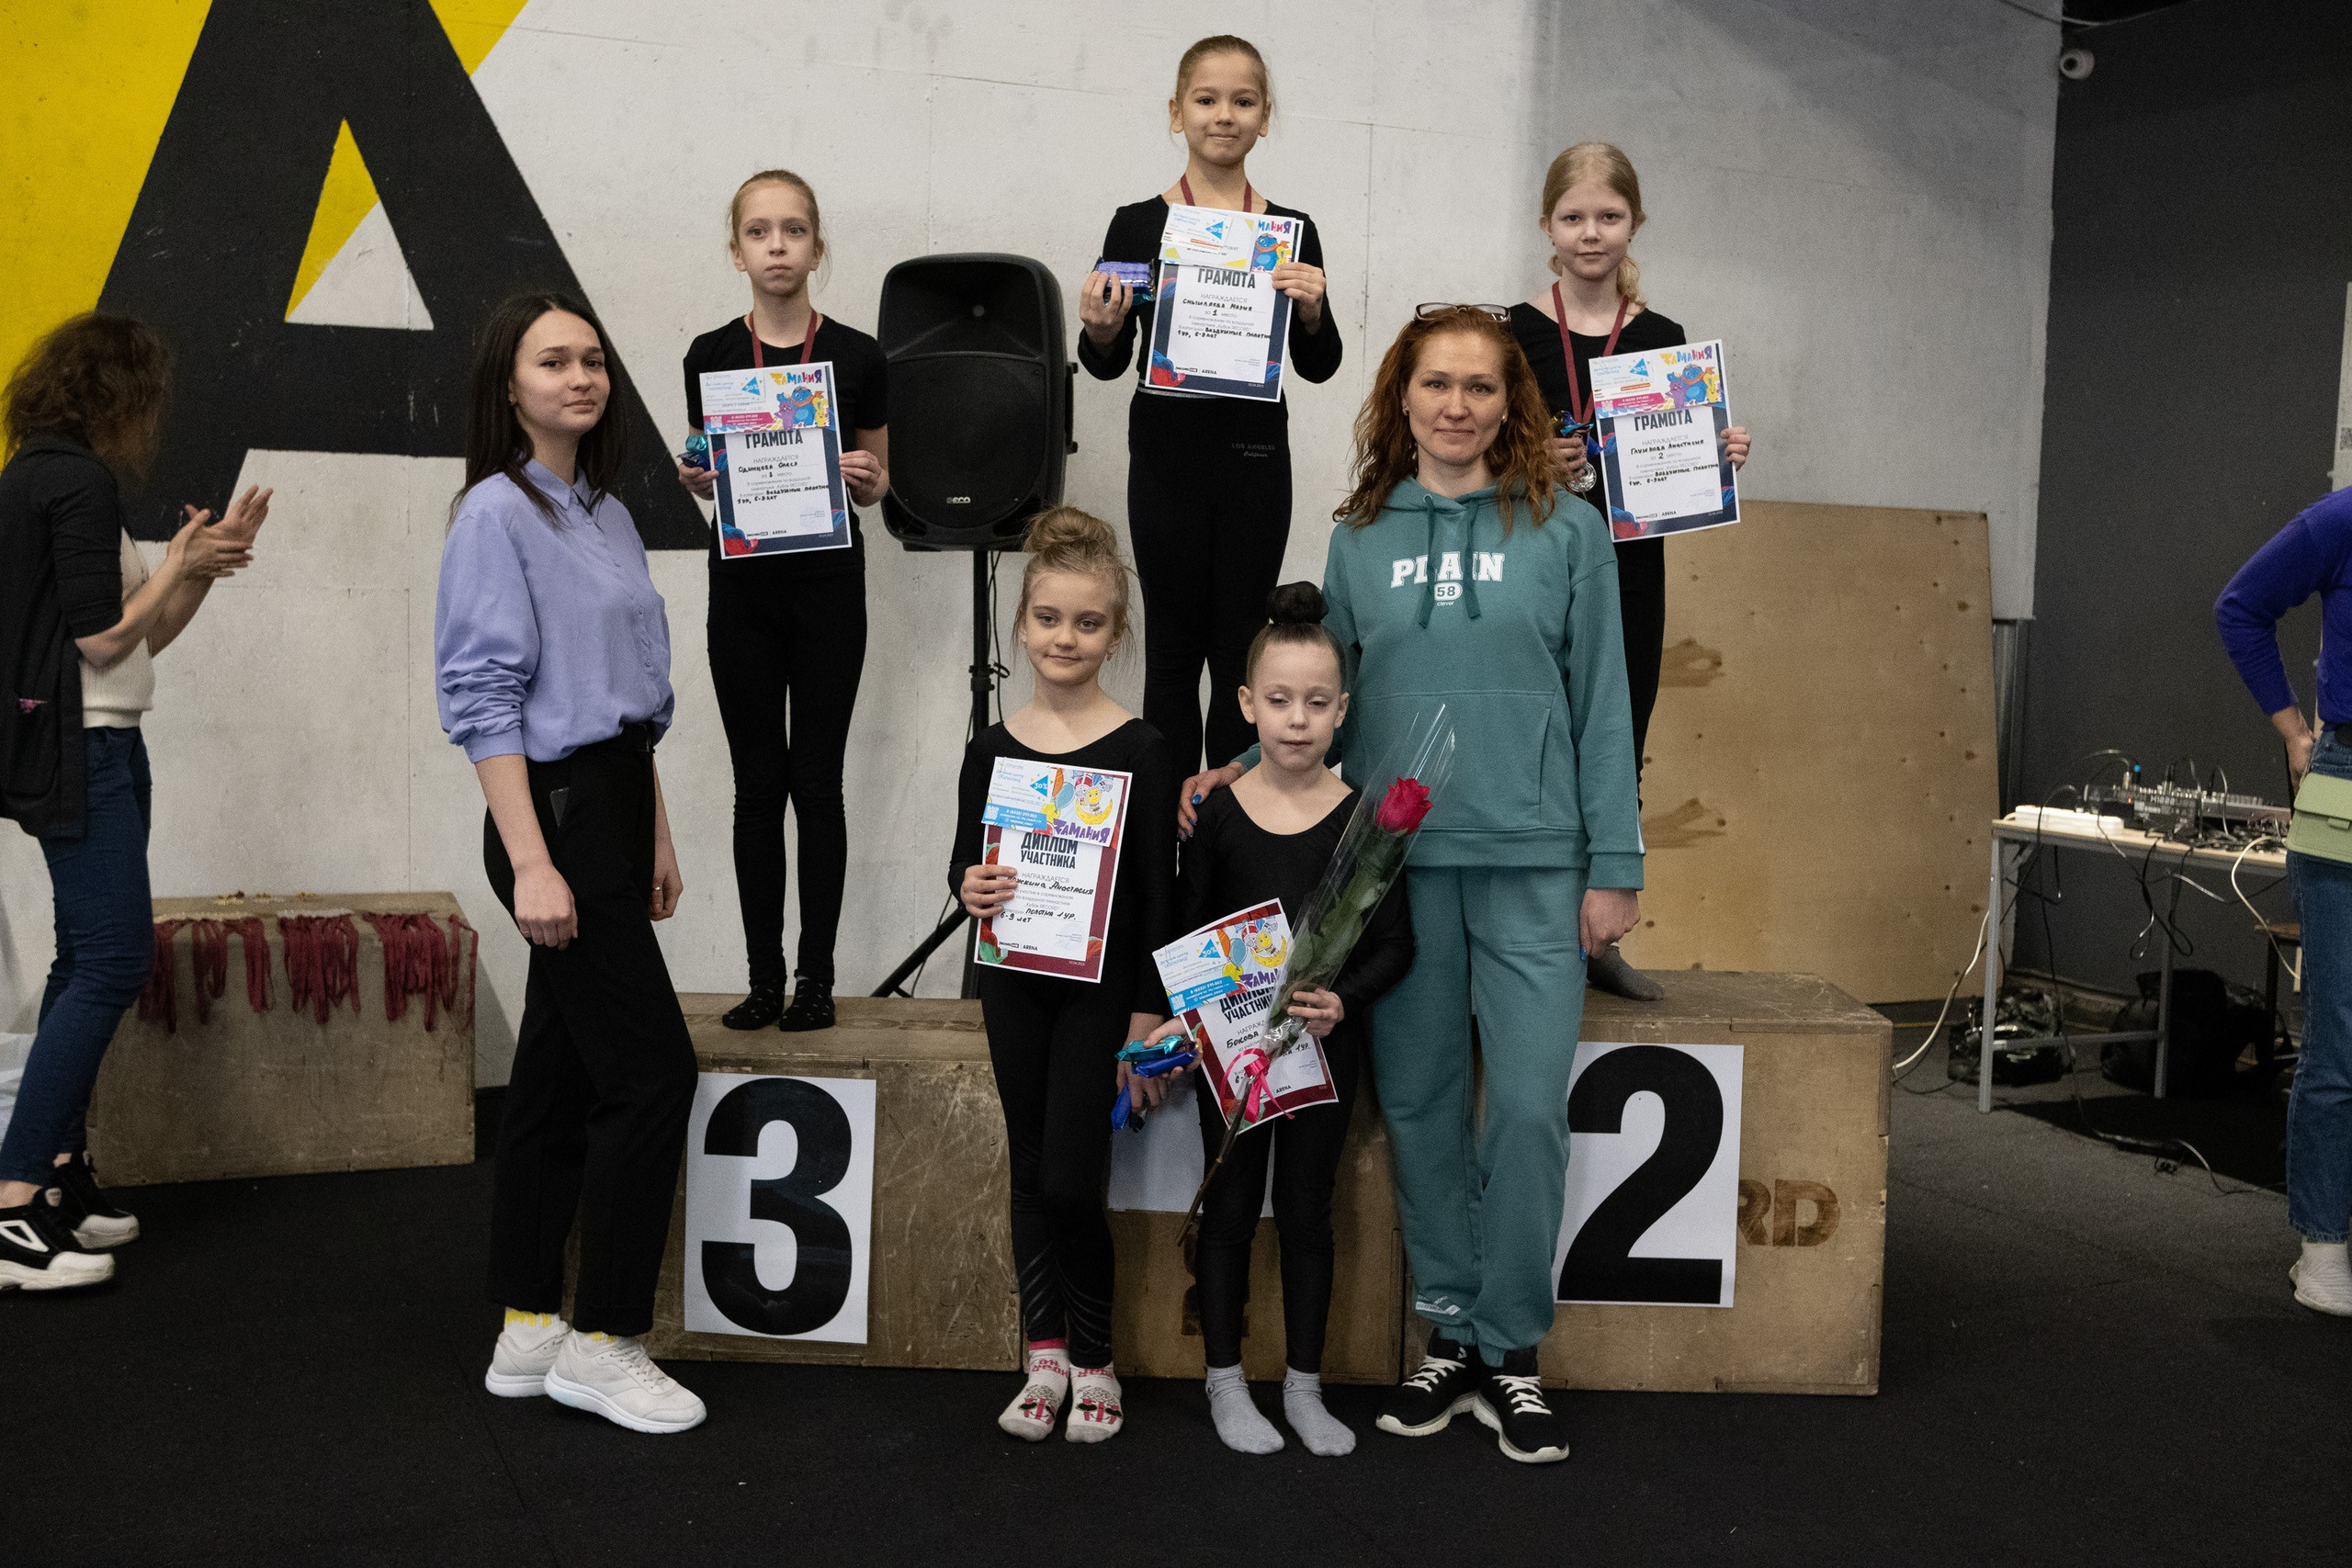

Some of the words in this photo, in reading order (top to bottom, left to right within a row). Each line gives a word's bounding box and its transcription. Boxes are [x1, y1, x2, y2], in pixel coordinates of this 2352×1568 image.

[1258, 220, 1292, 234] МАНИЯ
[1197, 268, 1256, 288] ГРАМОТА
[1200, 293, 1248, 303] НАГРАЖДАЕТСЯ
[1634, 409, 1692, 432] ГРАМОТА
[745, 430, 803, 449] ГРАМОТА
[1642, 434, 1688, 446] НАГРАЖДАЕТСЯ
[752, 455, 799, 463] НАГРАЖДАЕТСЯ
[1437, 586, 1455, 597] 58
[1021, 832, 1079, 855] ДИПЛОМ
[1020, 850, 1076, 870] УЧАСТНИКА
[1022, 873, 1069, 884] НАГРАЖДАЕТСЯ
[1001, 911, 1014, 920] 6-9
[1202, 947, 1217, 957] 30%
[1219, 987, 1275, 1013] ДИПЛО
[1224, 994, 1272, 1023] УЧАСТНИ
[1237, 1020, 1265, 1035] НАГРАЖ
[1227, 1031, 1259, 1048] Бокова
[1276, 1085, 1292, 1094] ARENA
[1557, 1045, 1724, 1304] 2
[701, 1077, 853, 1336] 3
